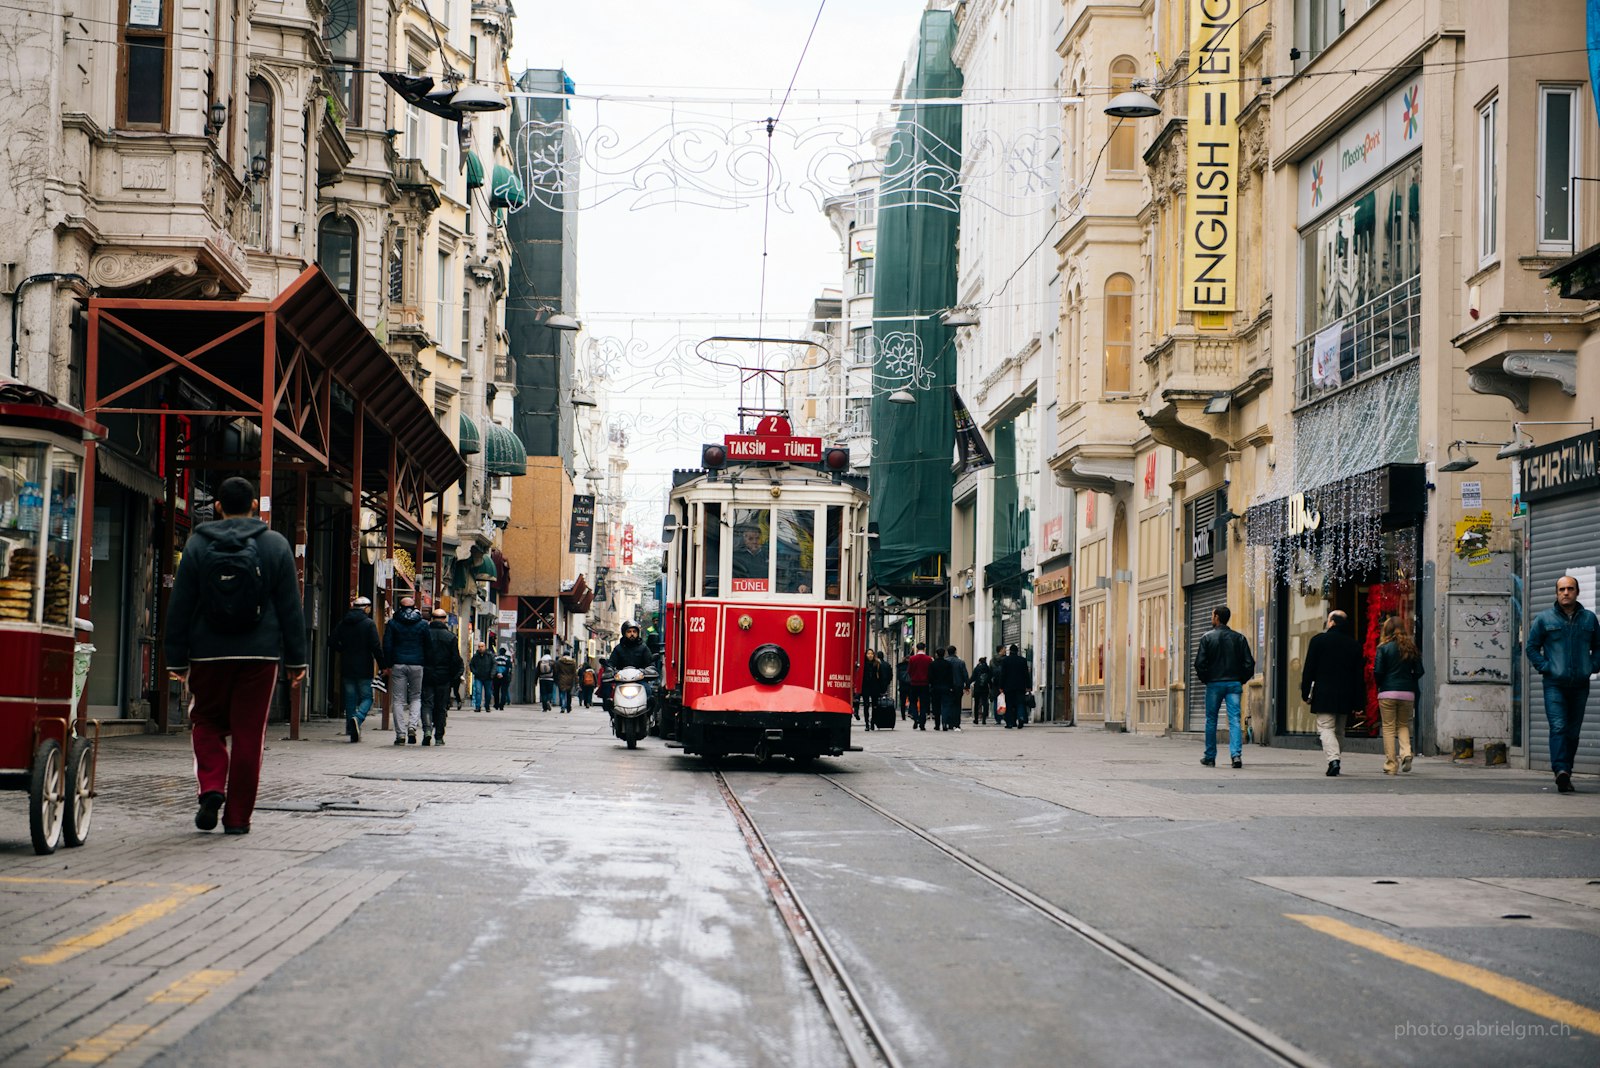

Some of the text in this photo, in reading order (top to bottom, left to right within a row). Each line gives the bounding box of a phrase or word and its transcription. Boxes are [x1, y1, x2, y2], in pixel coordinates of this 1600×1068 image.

[1194, 142, 1230, 305] ENGLISH
[769, 417, 778, 432] 2
[784, 441, 818, 457] TÜNEL
[734, 580, 767, 591] TÜNEL
[689, 617, 705, 632] 223
[835, 622, 851, 637] 223
